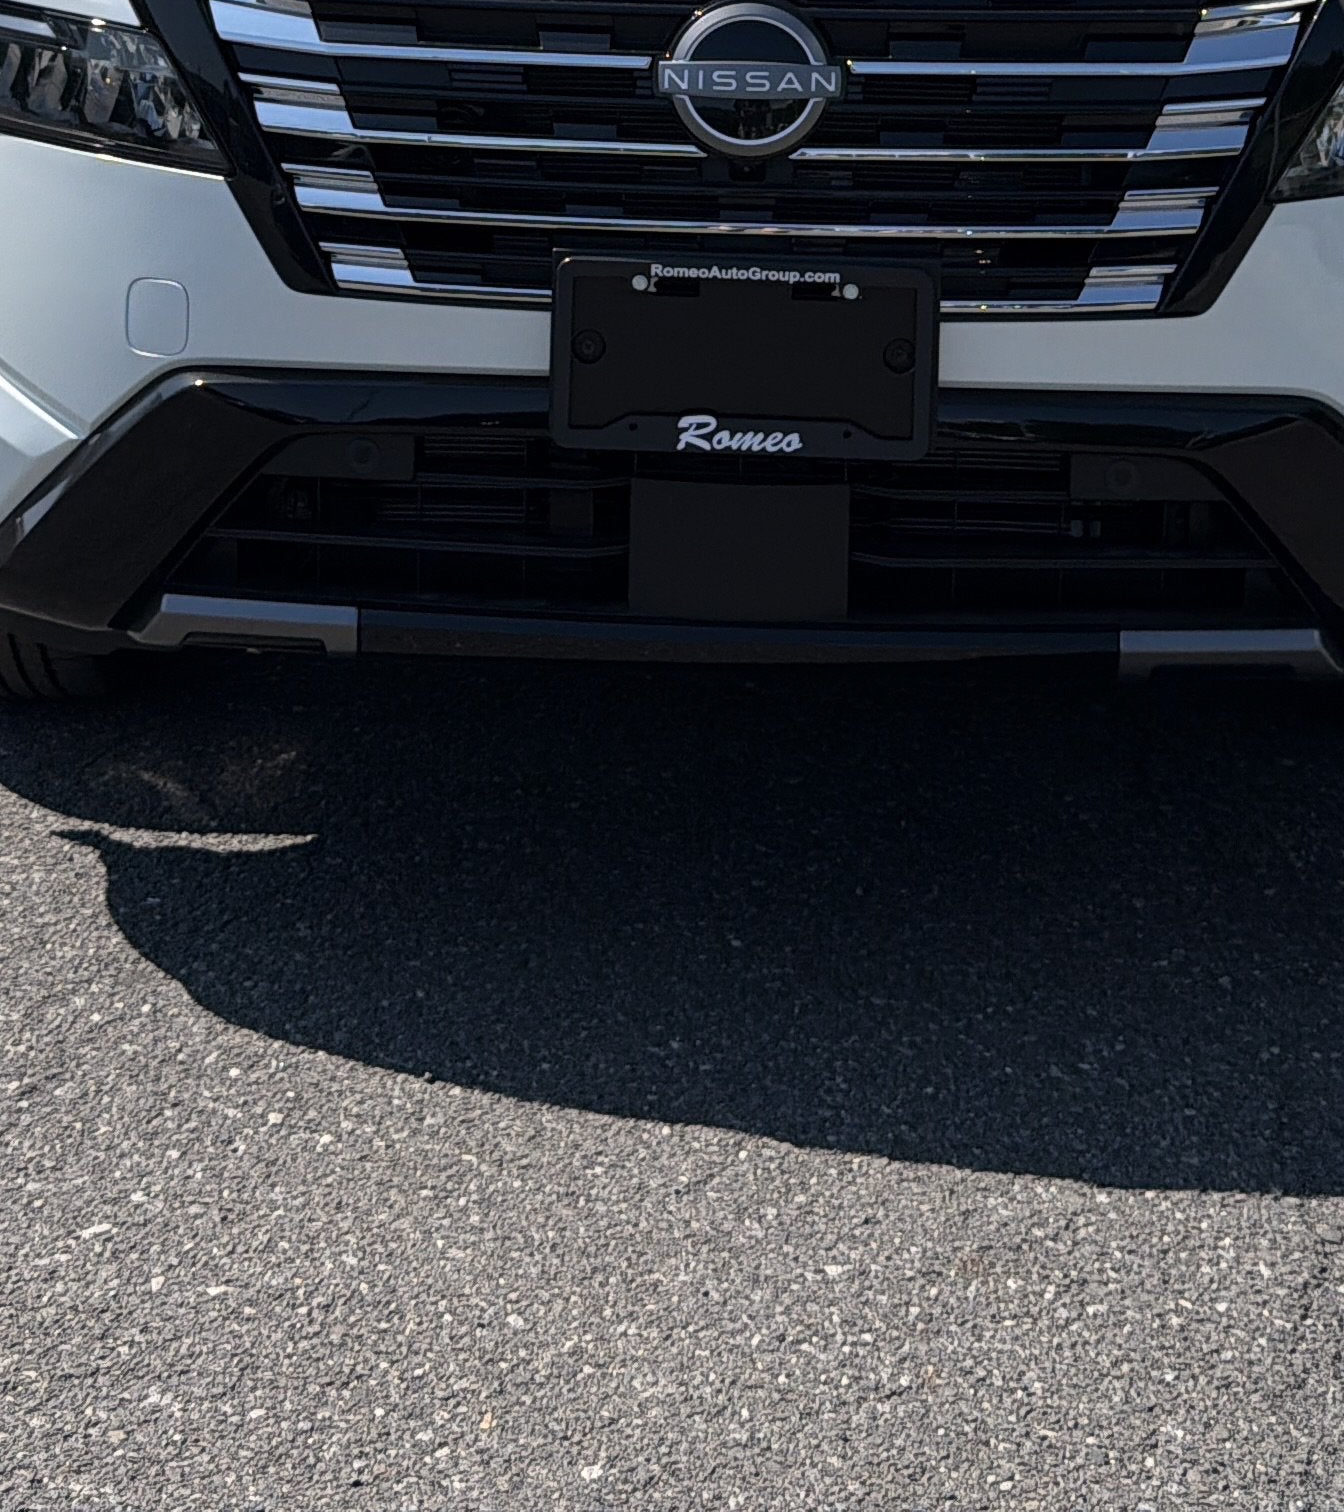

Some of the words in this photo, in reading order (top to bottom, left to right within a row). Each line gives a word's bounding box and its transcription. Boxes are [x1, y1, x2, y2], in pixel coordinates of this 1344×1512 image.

[664, 68, 836, 92] NISSAN
[650, 263, 840, 284] RomeoAutoGroup.com
[676, 414, 803, 452] Romeo
